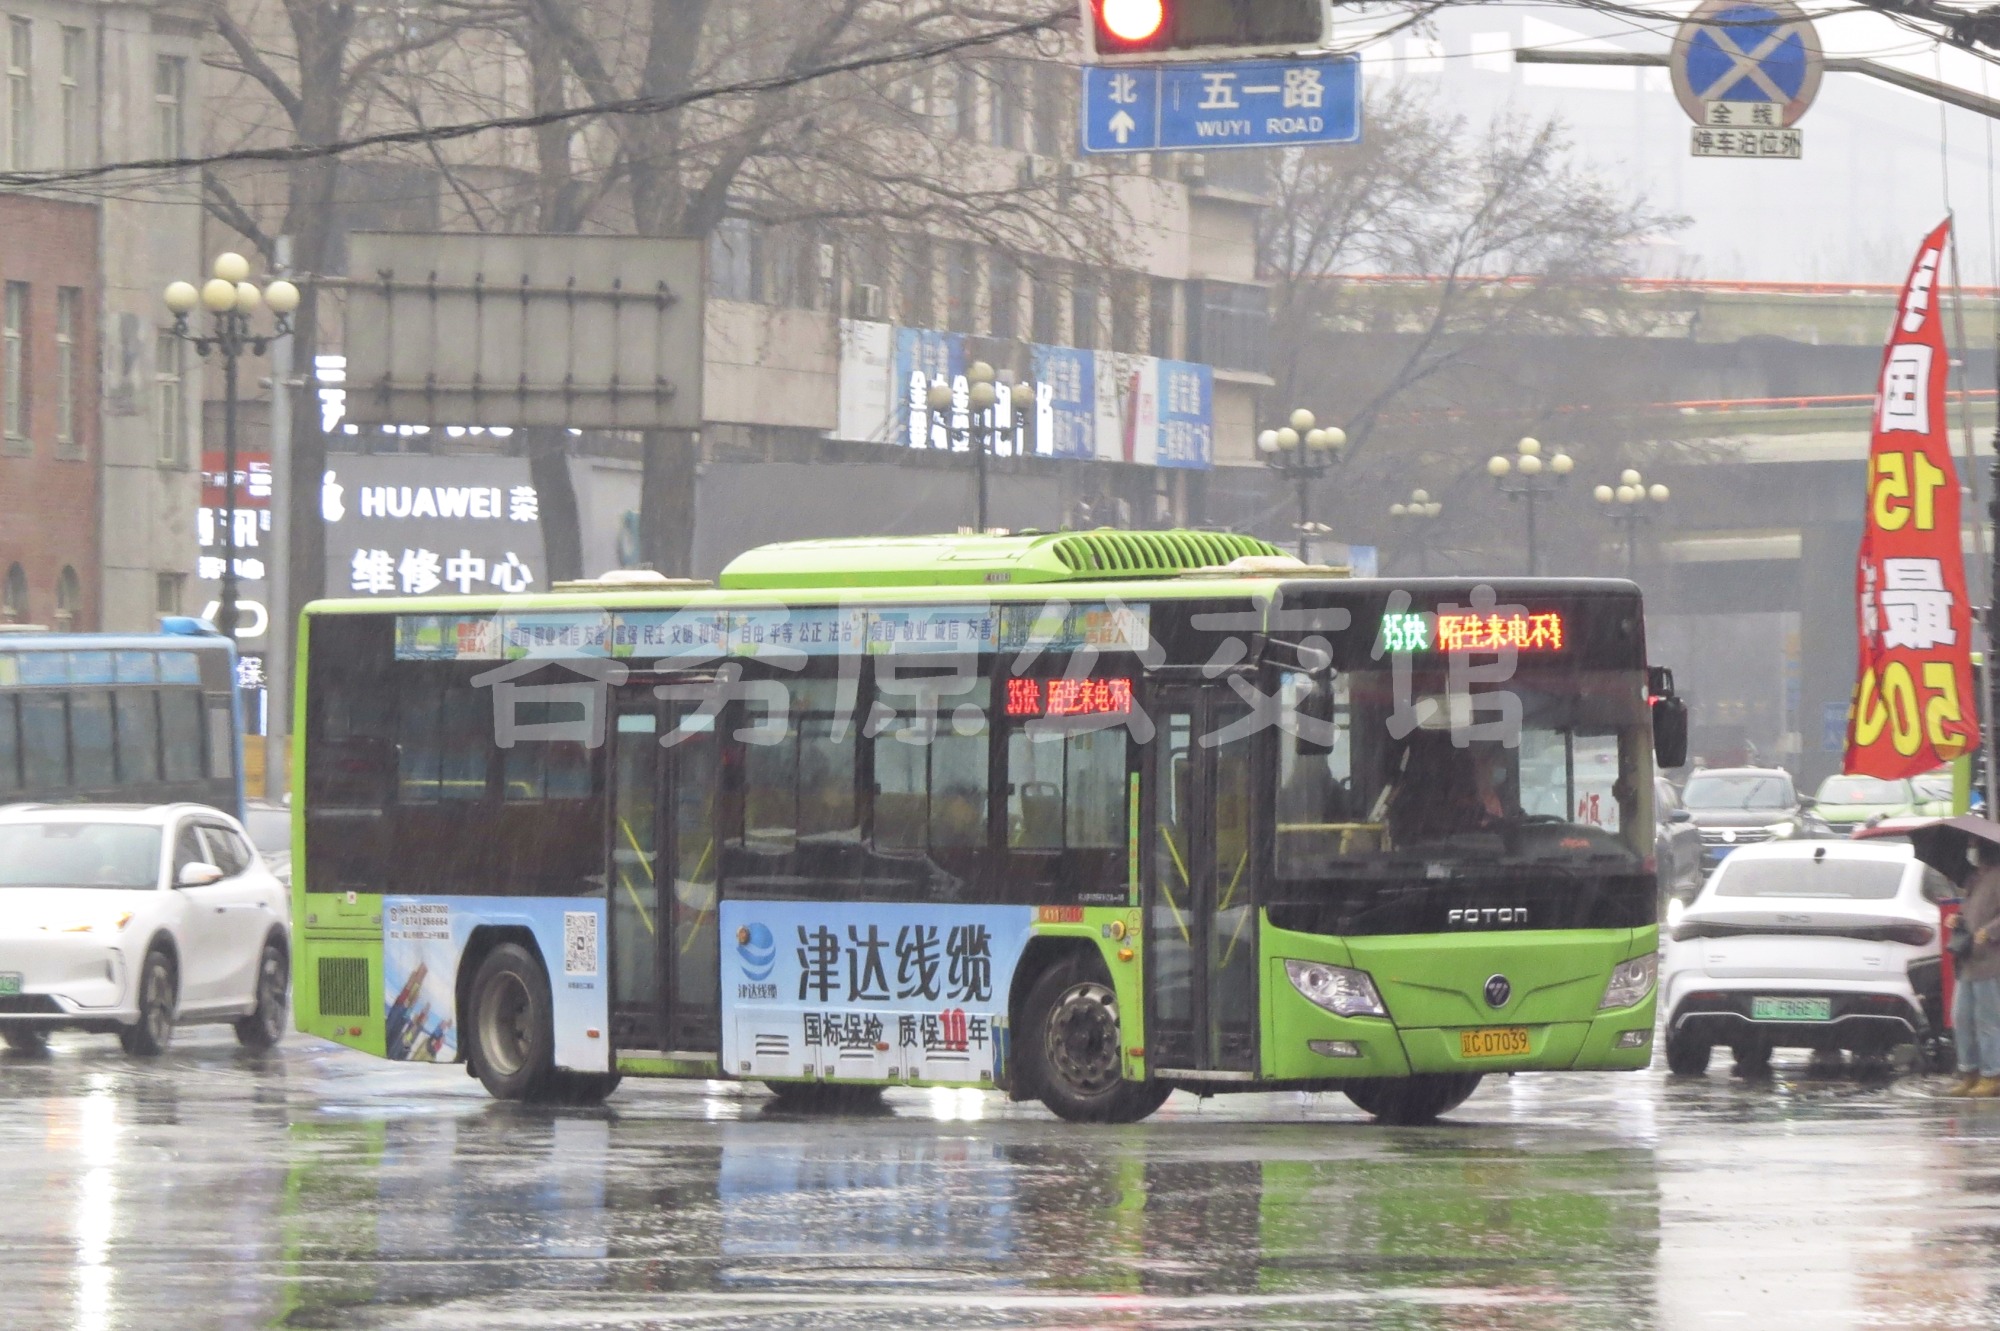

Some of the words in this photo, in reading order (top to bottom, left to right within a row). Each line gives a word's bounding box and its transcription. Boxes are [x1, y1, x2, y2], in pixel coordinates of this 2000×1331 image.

[1108, 73, 1138, 104] 北
[1198, 68, 1325, 109] 五一路
[1196, 120, 1250, 137] WUYI
[1266, 117, 1324, 134] ROAD
[1694, 131, 1801, 156] 停车泊位外
[361, 486, 502, 518] HUAWEI
[509, 485, 539, 522] 荣
[351, 548, 534, 594] 维修中心
[644, 625, 666, 646] 民主
[672, 625, 693, 645] 文明
[742, 623, 763, 644] 自由
[770, 622, 793, 643] 平等
[800, 622, 823, 643] 公正
[967, 619, 992, 641] 友善
[1449, 908, 1528, 924] FOTON
[797, 925, 993, 1002] 津达线缆
[738, 983, 777, 1000] 津达线缆
[803, 1012, 884, 1048] 国标保检
[898, 1008, 989, 1052] 质保10年
